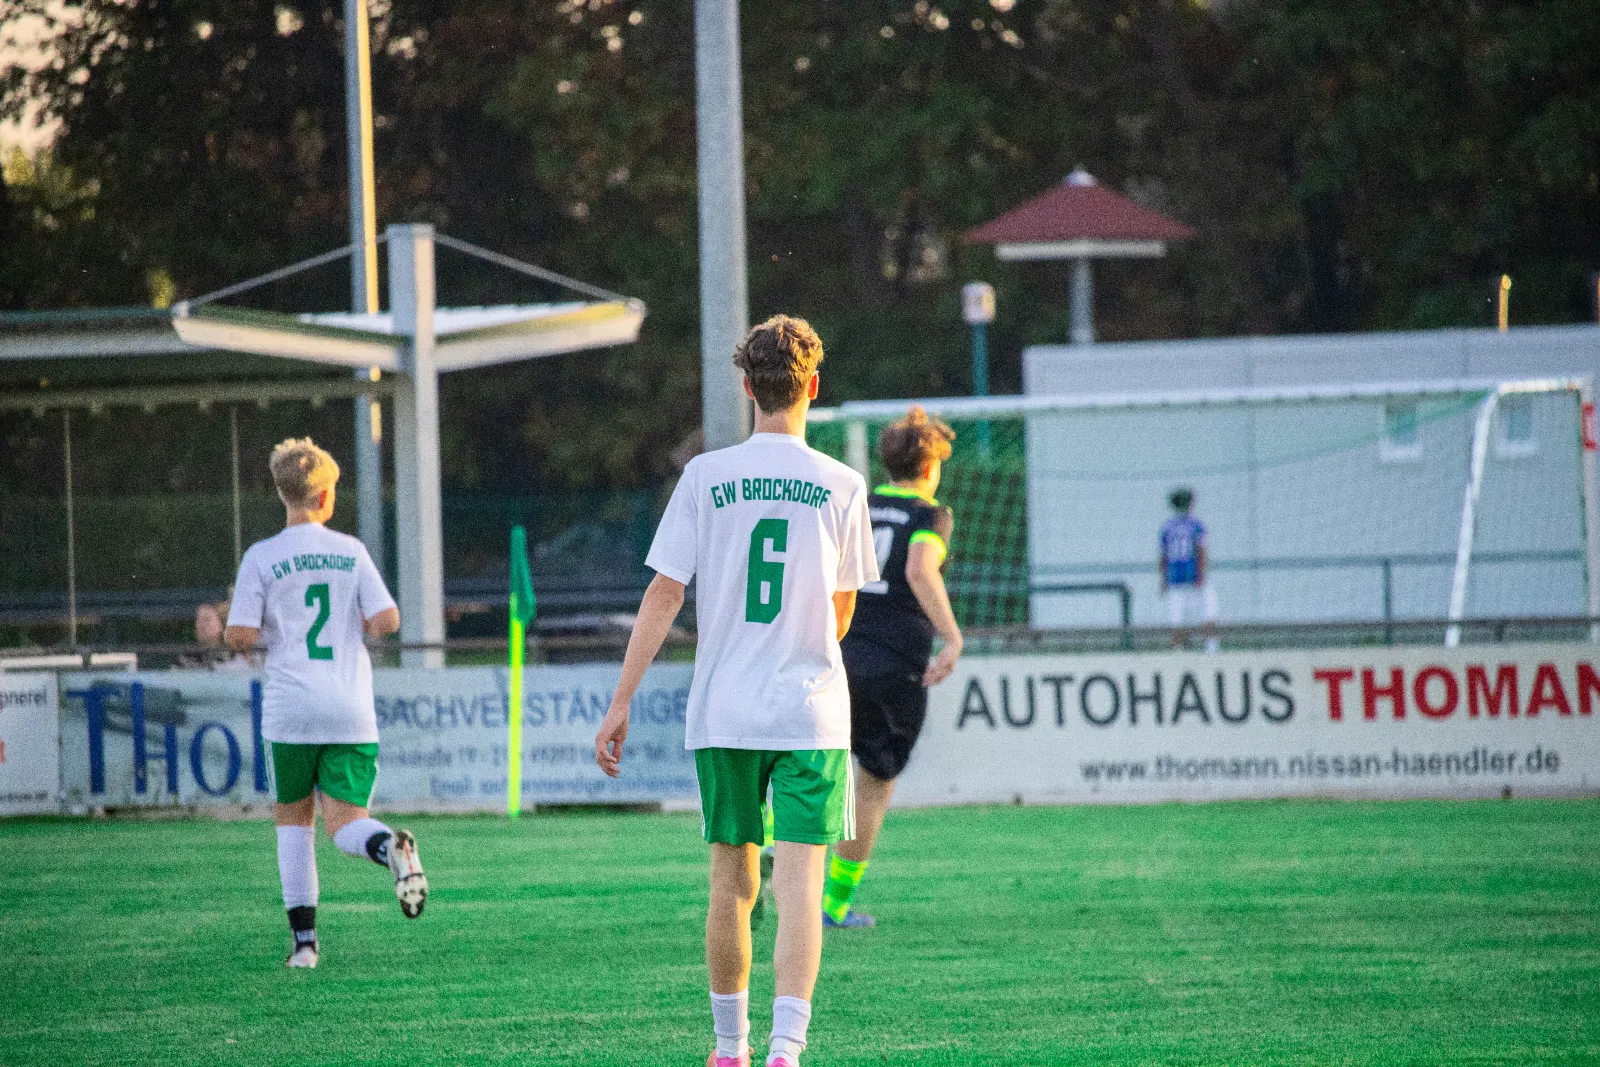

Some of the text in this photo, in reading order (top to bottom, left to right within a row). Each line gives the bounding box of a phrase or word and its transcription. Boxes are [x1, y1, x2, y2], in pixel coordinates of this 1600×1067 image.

[710, 478, 831, 509] GW BROCKDORF
[271, 553, 356, 579] GW BROCKDORF
[745, 518, 789, 624] 6
[305, 583, 333, 660] 2
[374, 687, 691, 728] SACHVESTÄNIGE
[956, 668, 1295, 730] AUTOHAUS
[1080, 746, 1560, 780] www.thomann.nissan-haendler.de
